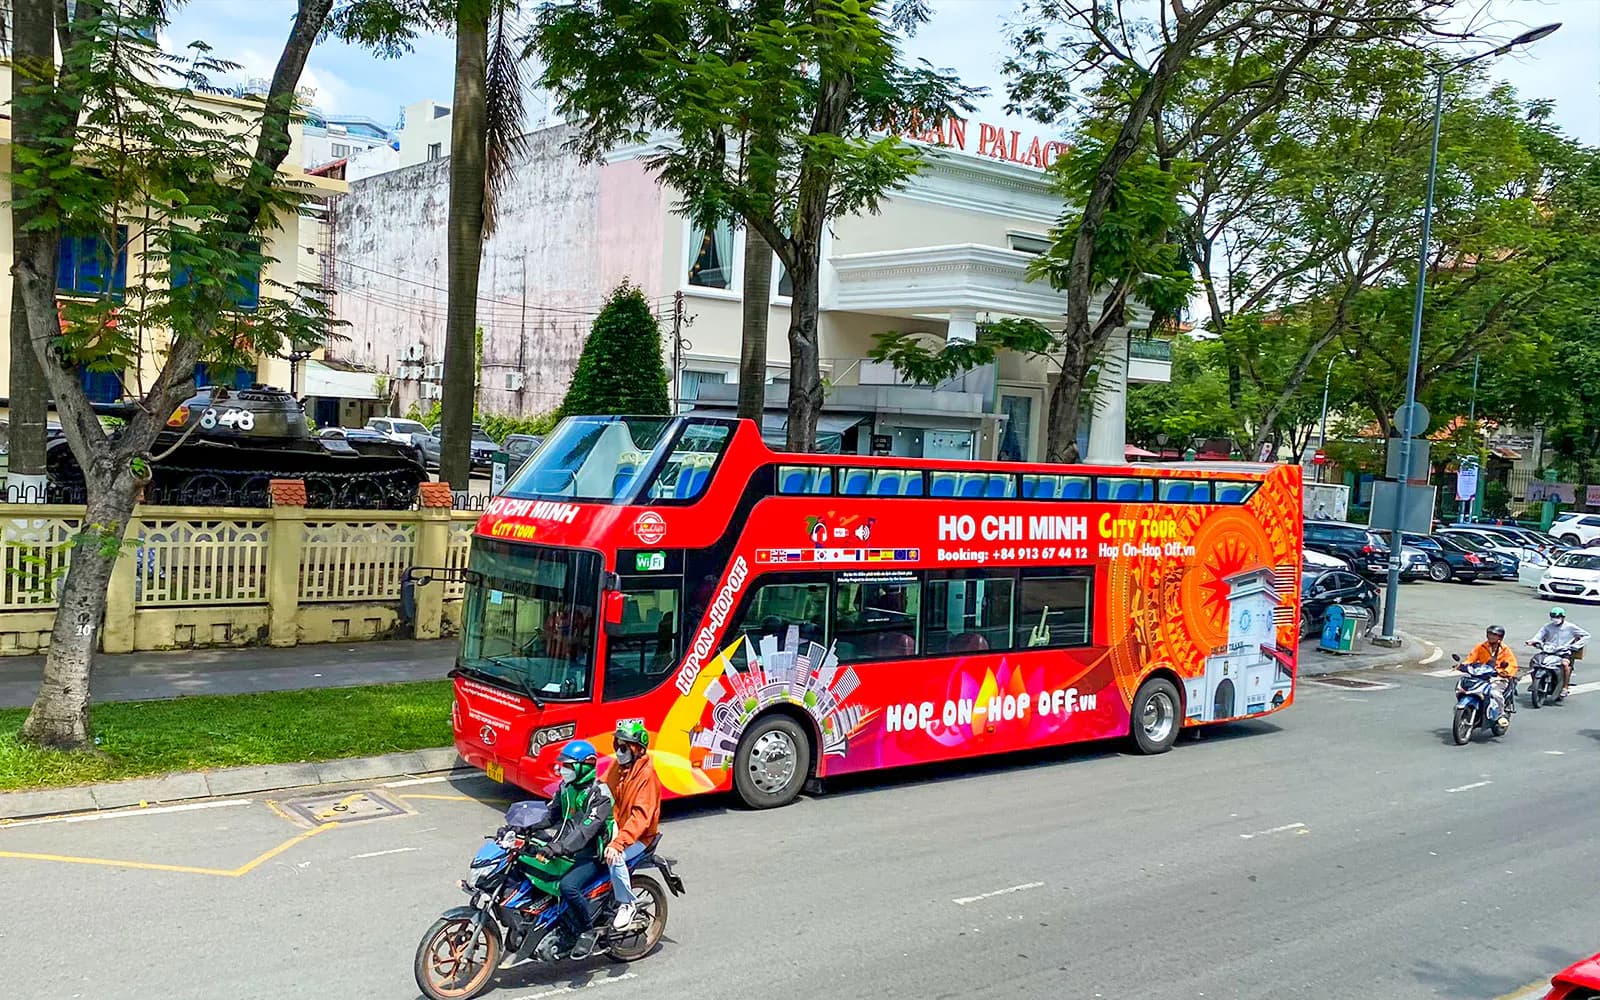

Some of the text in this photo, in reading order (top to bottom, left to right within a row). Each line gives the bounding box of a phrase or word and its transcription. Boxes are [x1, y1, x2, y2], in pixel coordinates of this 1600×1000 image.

[200, 408, 255, 431] 848
[483, 499, 580, 524] HO CHI MINH
[512, 524, 537, 539] TOUR
[938, 515, 1088, 541] HO CHI MINH
[1140, 519, 1178, 539] TOUR
[937, 547, 1088, 563] Booking: +84 913 67 44 12
[1098, 542, 1119, 560] Hop
[1164, 541, 1196, 557] Off.vn
[676, 656, 701, 696] HOP
[728, 556, 748, 592] OFF
[886, 701, 934, 732] HOP
